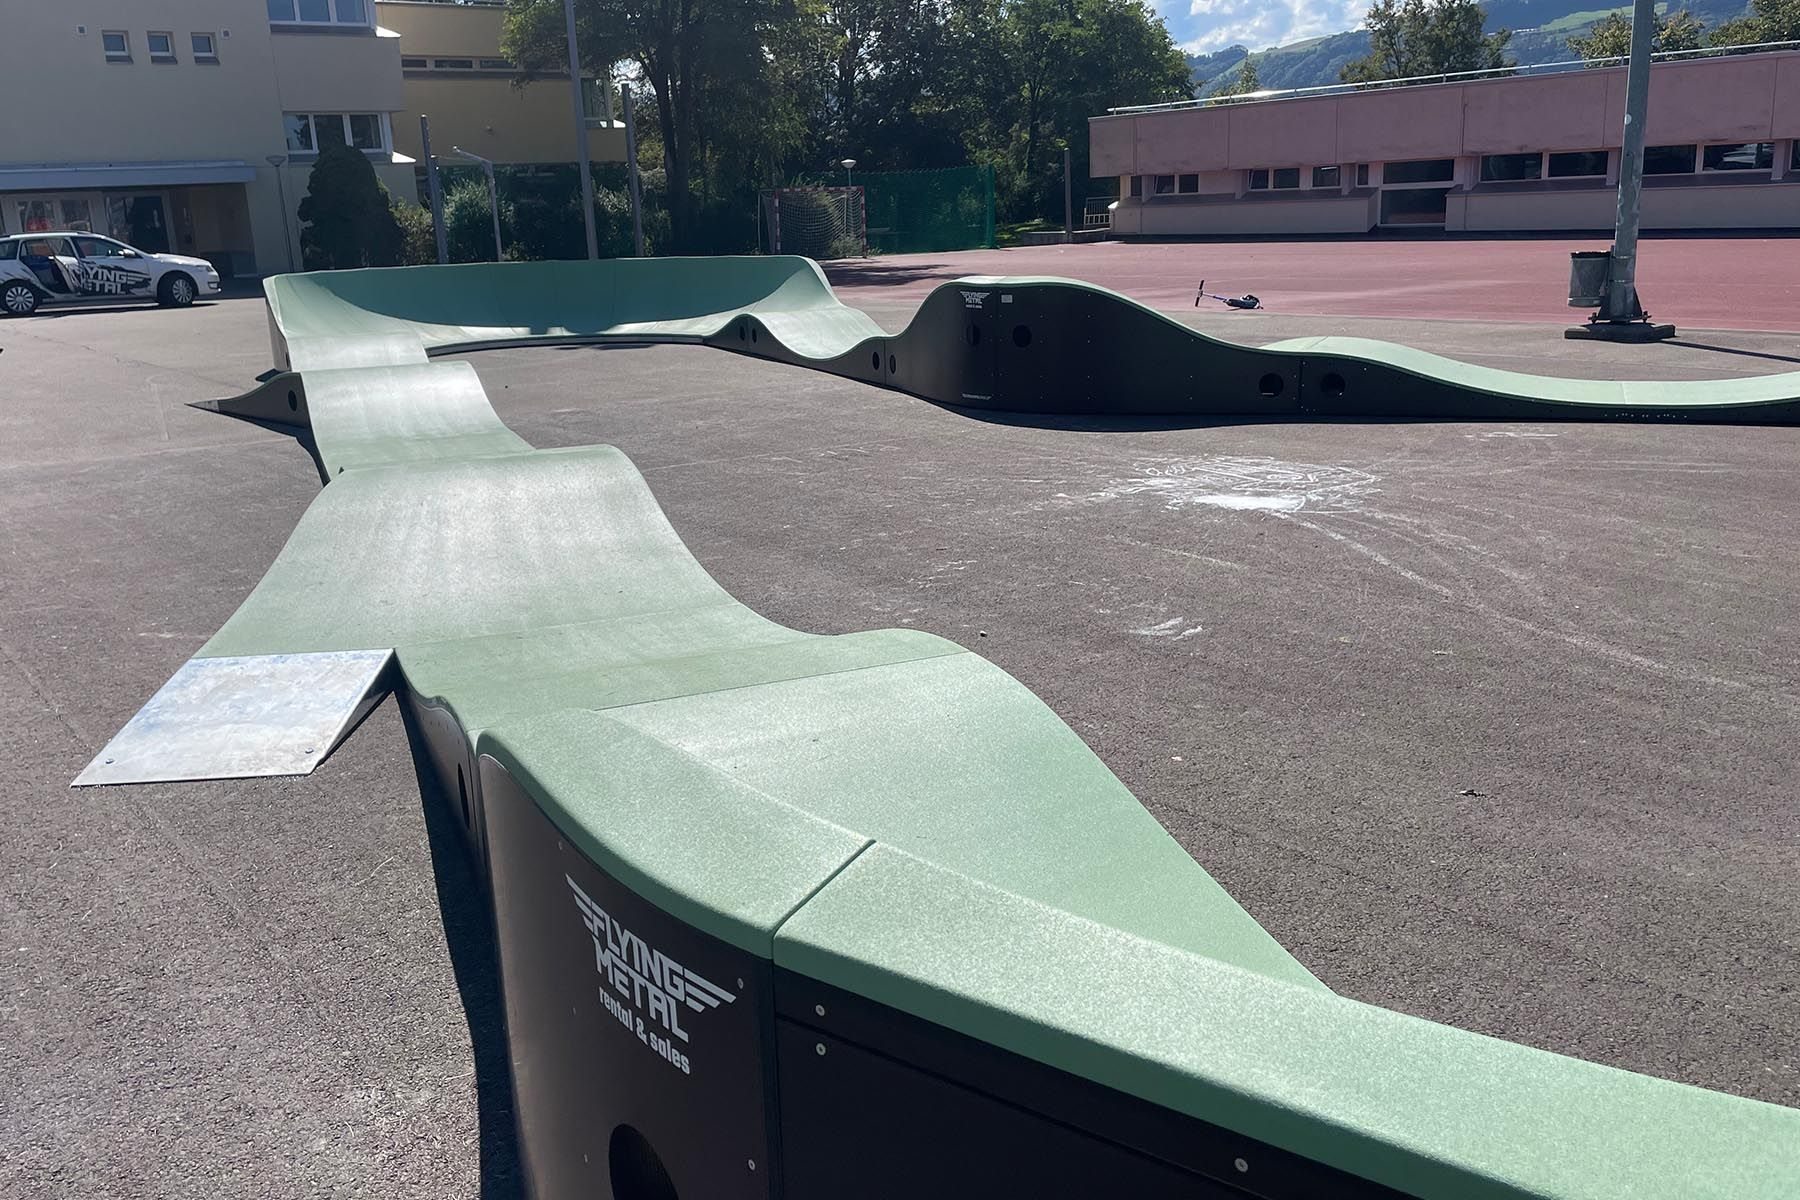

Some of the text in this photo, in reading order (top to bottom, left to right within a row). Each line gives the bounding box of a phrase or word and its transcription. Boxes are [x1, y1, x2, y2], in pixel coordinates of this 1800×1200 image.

[591, 901, 686, 1001] FLYING
[592, 935, 688, 1043] METAL
[599, 986, 690, 1074] rental & sales
